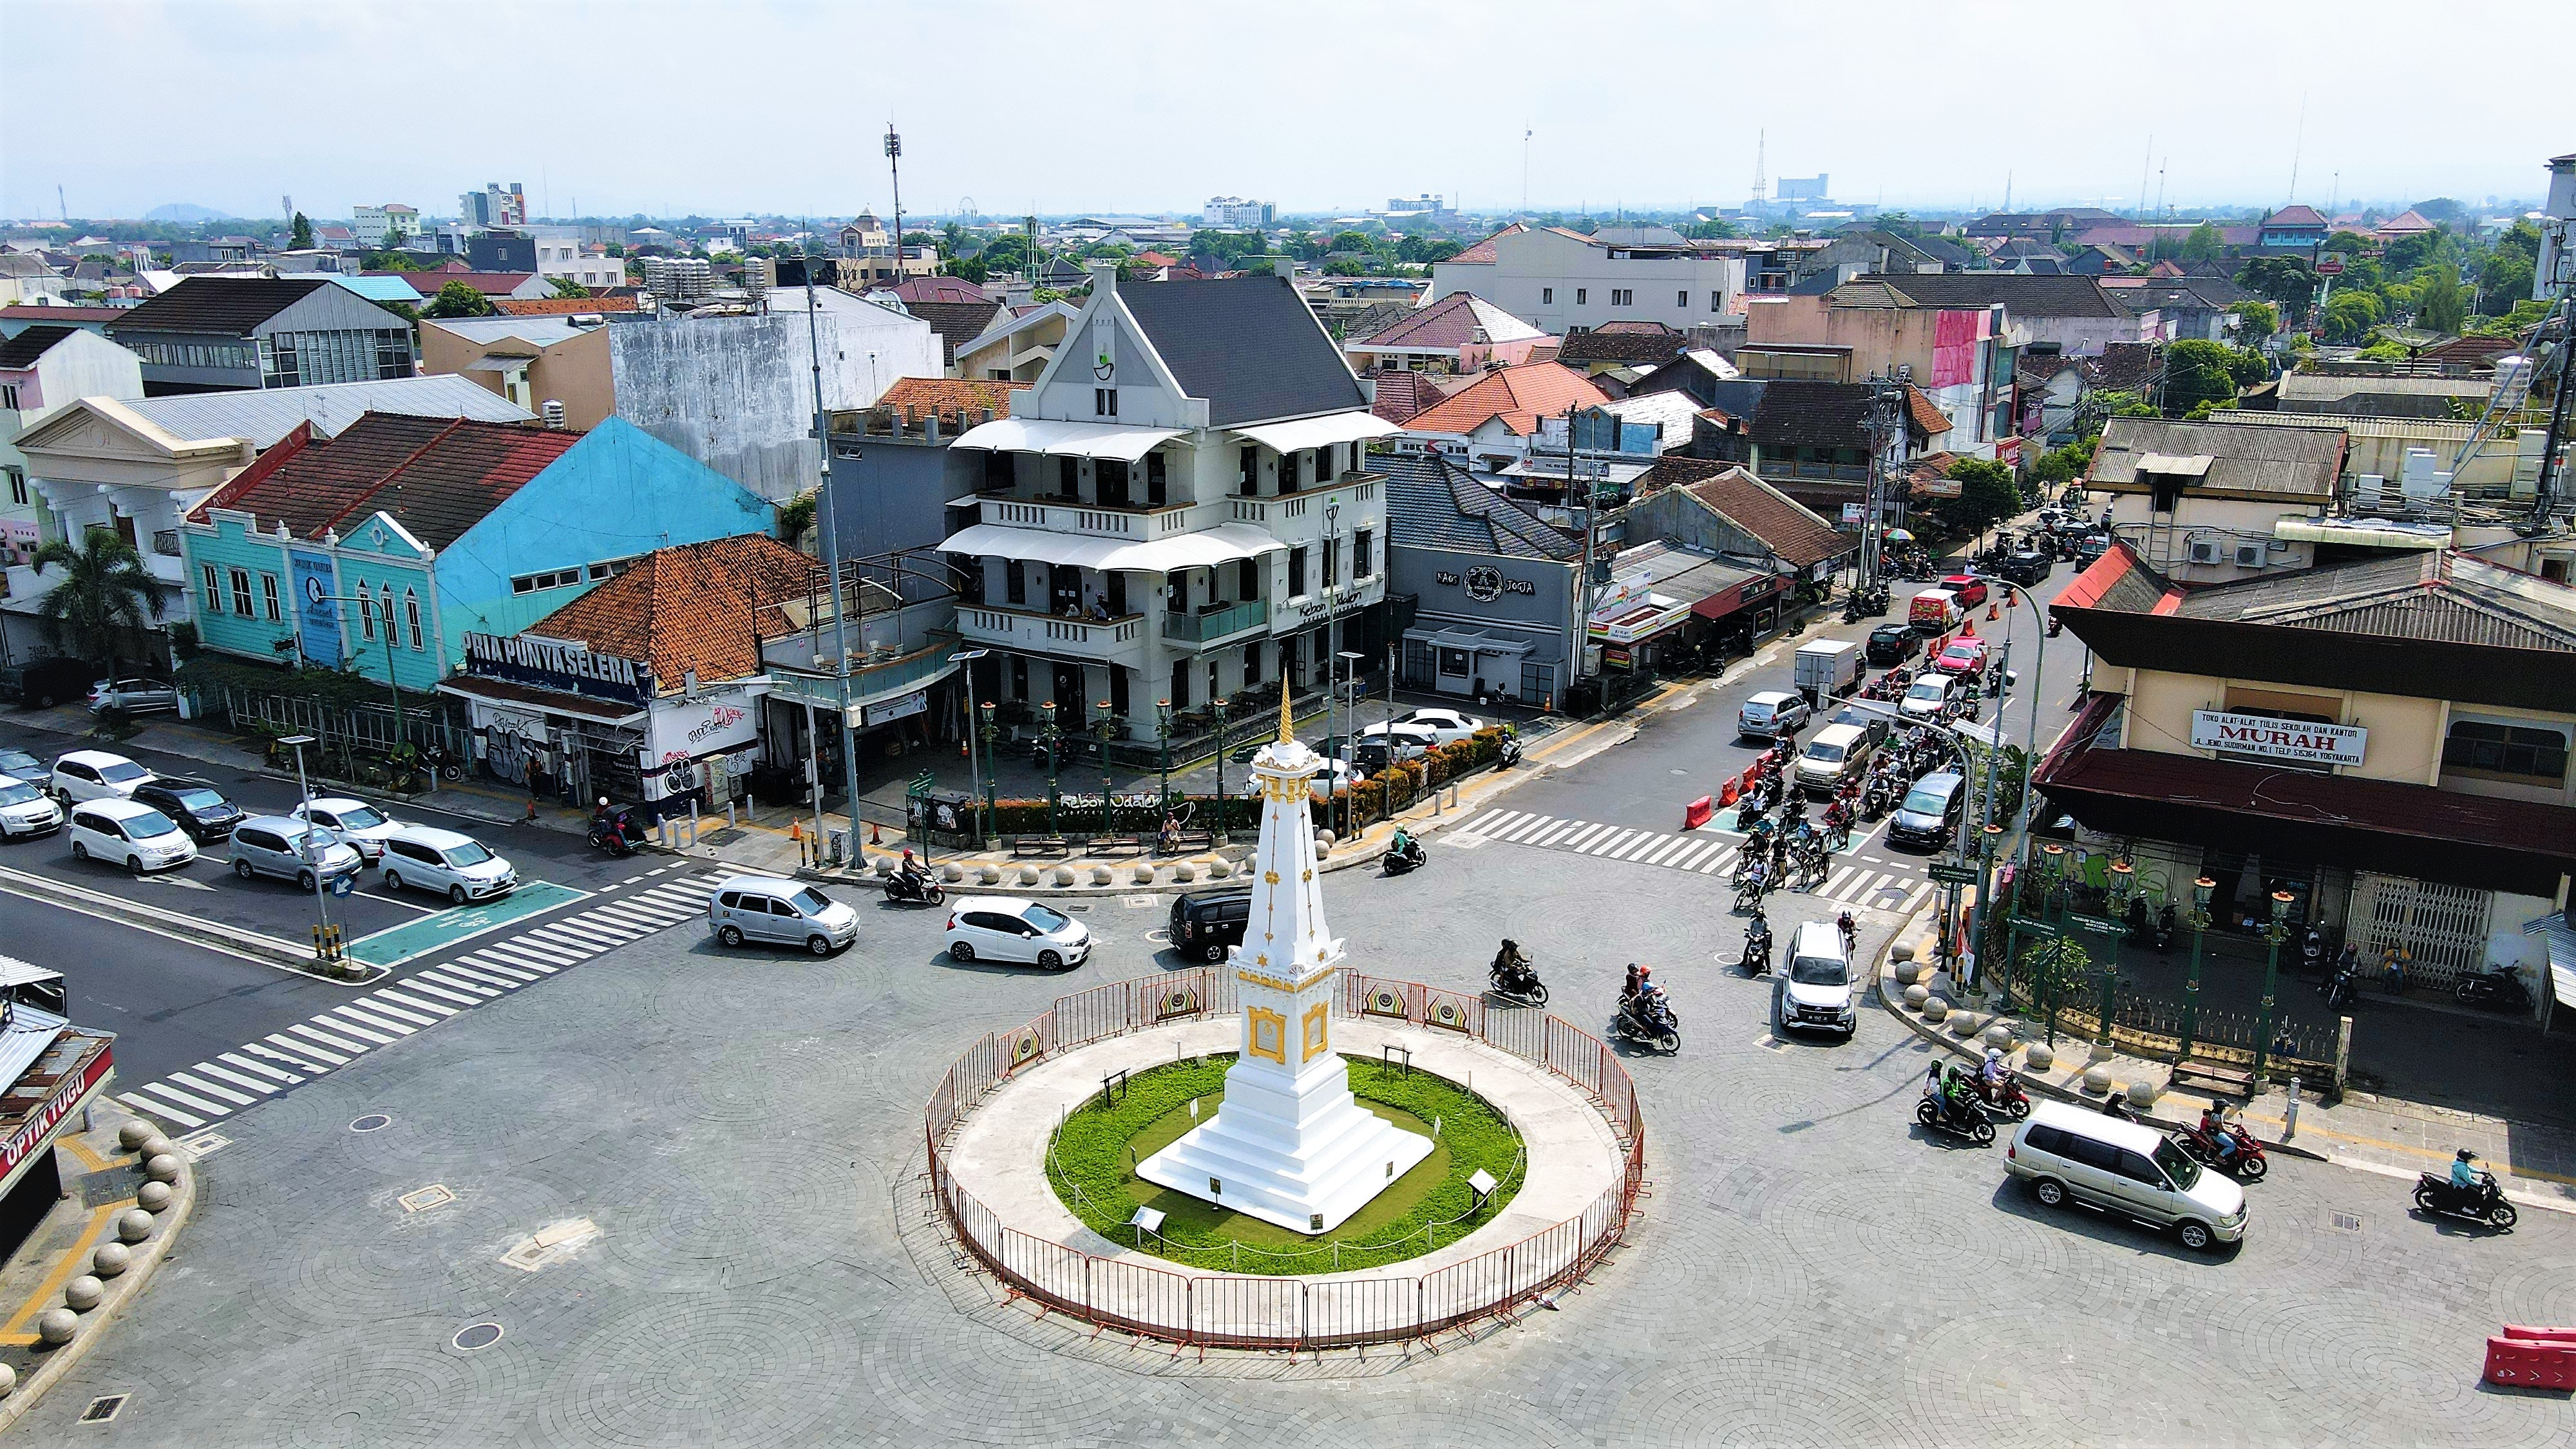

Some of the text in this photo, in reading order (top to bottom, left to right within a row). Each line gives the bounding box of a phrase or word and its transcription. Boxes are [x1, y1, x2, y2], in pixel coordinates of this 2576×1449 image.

[1437, 573, 1458, 584] KAOS
[1300, 602, 1326, 616] Kebon
[460, 631, 637, 686] PRIA PUNYA SELERA
[2202, 714, 2219, 723] TOKO
[2222, 715, 2256, 726] ALAT-ALAT
[2260, 719, 2278, 729] TULIS
[2281, 723, 2311, 733] SEKOLAH
[2331, 728, 2358, 738] KANTOR
[2219, 725, 2337, 751] MURAH
[2224, 741, 2255, 752] SUDIRMAN
[2275, 747, 2291, 755] TELP
[2320, 752, 2360, 764] YOGYAKARTA
[1060, 793, 1105, 808] Kebon
[6, 1109, 50, 1166] OPTIK
[49, 1072, 85, 1121] TUGU
